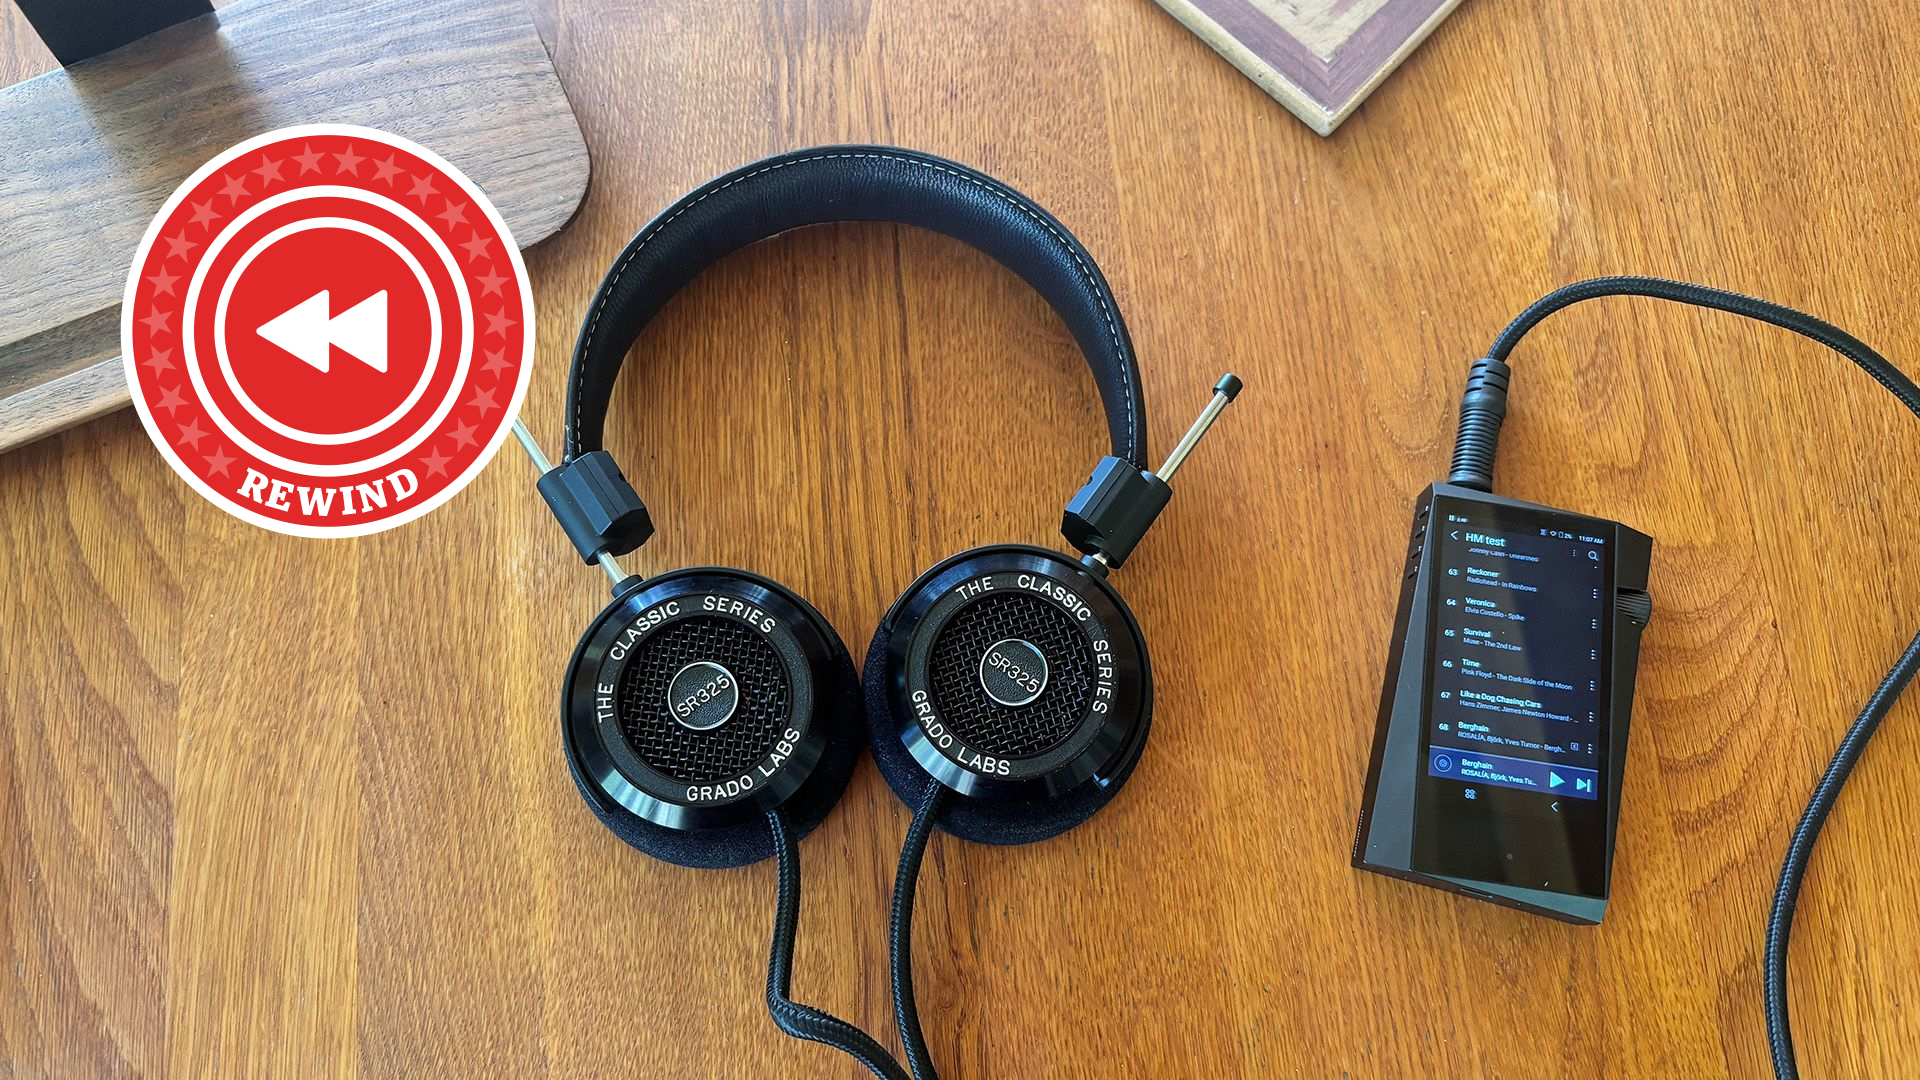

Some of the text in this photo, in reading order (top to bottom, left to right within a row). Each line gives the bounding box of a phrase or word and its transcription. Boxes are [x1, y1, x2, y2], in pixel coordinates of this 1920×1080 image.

[1465, 532, 1506, 547] HM test
[1448, 568, 1458, 576] 63
[1467, 567, 1500, 578] Reckoner
[1466, 576, 1498, 586] Radiohead
[1508, 582, 1537, 592] Rainbows
[1446, 598, 1456, 606] 64
[1465, 597, 1496, 608] Veronica
[1465, 606, 1479, 615] Elvis
[1480, 608, 1504, 618] Costello
[1508, 612, 1525, 621] Spike
[1444, 629, 1455, 637] 65
[1463, 627, 1492, 638] Survival
[956, 574, 1113, 714] THE CLASSIC SERIES
[1463, 637, 1480, 645] Muse
[596, 595, 776, 723] THE CLASSIC SERIES
[1442, 660, 1453, 668] 66
[1462, 658, 1481, 668] Time
[988, 652, 1040, 693] SR325
[1461, 667, 1476, 676] Pink
[1475, 670, 1492, 679] Floyd
[1496, 673, 1508, 681] The
[1508, 675, 1522, 683] Dark
[1522, 677, 1537, 685] Side
[1555, 683, 1573, 691] Moon
[676, 674, 730, 717] SR325
[1441, 691, 1451, 699] 67
[1460, 690, 1475, 699] Like
[1481, 693, 1496, 703] Dog
[1496, 695, 1525, 707] Chasing
[1525, 699, 1542, 709] Cars
[1459, 699, 1476, 708] Hans
[1476, 702, 1501, 712] Zimmer,
[1501, 706, 1521, 714] James
[1522, 708, 1546, 718] Newton
[1545, 712, 1570, 722] Howard
[912, 690, 1011, 776] GRADO LABS
[1439, 723, 1449, 731] 68
[1458, 721, 1489, 733] Berghain
[1504, 738, 1520, 746] Yves
[1520, 740, 1540, 749] Tumor
[686, 727, 800, 802] GRADO LABS
[1461, 758, 1493, 770] Berghain
[1508, 775, 1524, 784] Yves
